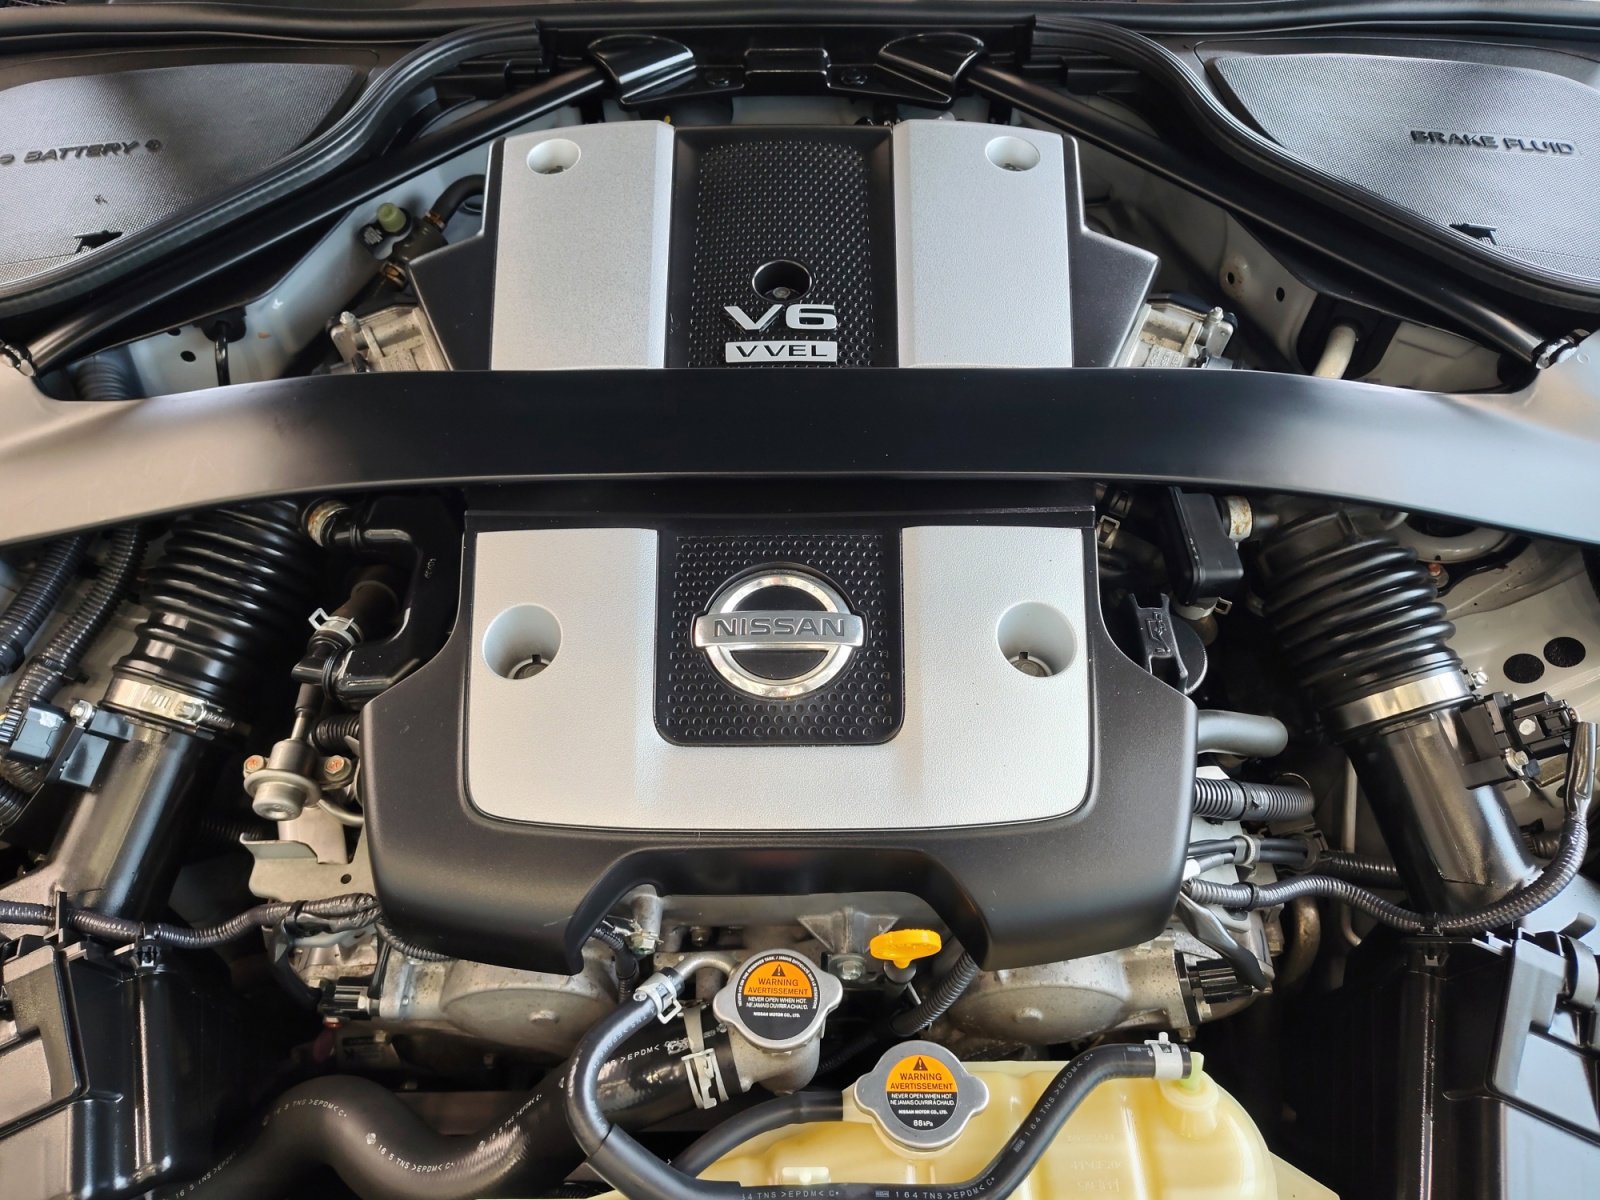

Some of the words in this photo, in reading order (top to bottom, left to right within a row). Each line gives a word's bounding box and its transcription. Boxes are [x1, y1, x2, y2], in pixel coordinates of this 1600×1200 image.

[1410, 130, 1499, 148] BRAKE
[1503, 137, 1574, 155] FLUID
[24, 140, 140, 163] BATTERY
[724, 303, 838, 331] V6
[735, 344, 828, 358] VVEL
[713, 617, 845, 637] NISSAN
[758, 978, 799, 987] WARNING
[748, 986, 809, 996] AVERTISSEMENT
[900, 1072, 942, 1081] WARNING
[890, 1082, 953, 1090] AVERTISSEMENT
[396, 1157, 410, 1169] TNS
[757, 1191, 777, 1199] TNS
